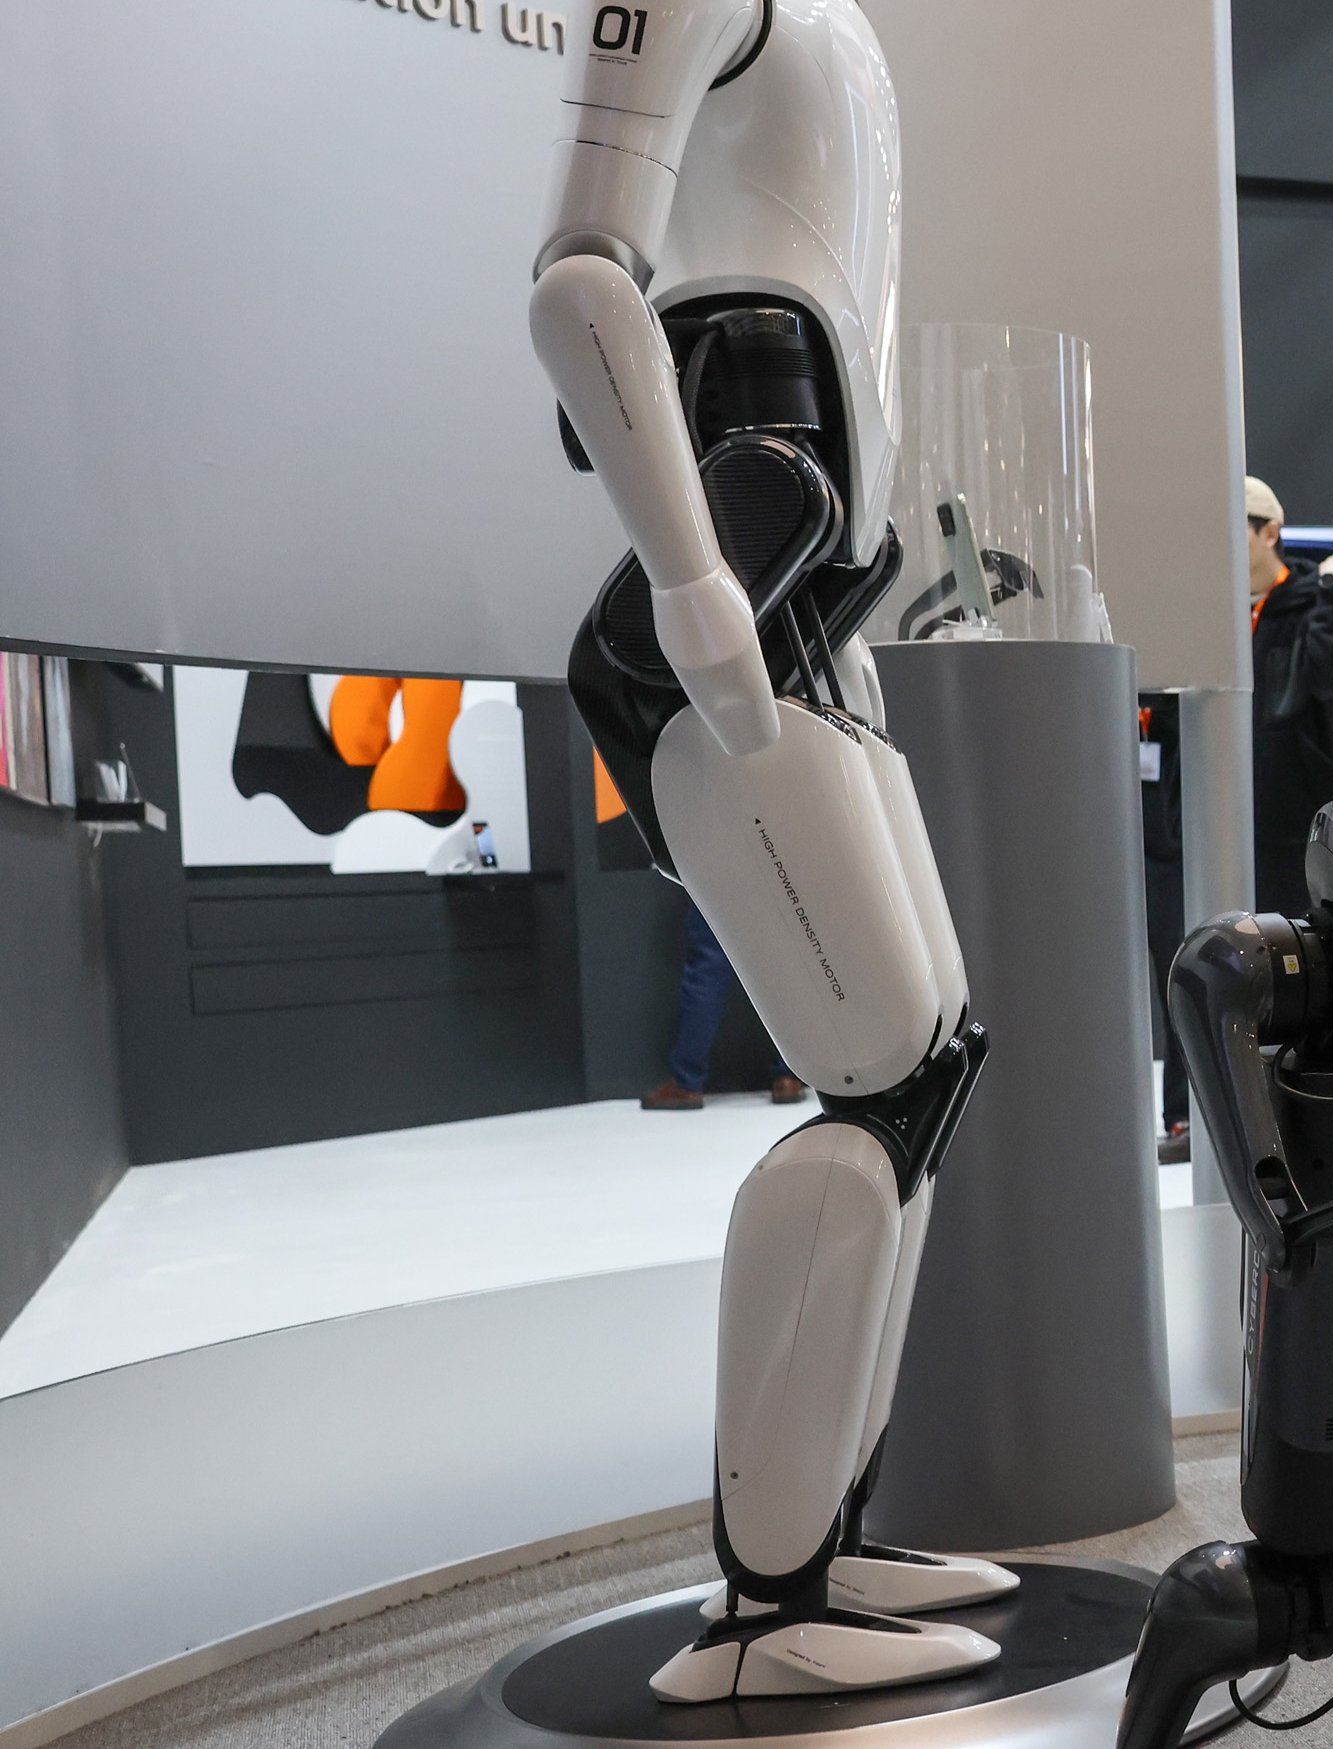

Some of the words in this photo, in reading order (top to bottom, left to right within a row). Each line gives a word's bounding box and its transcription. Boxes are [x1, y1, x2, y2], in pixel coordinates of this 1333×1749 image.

[592, 5, 648, 55] 01
[759, 828, 777, 858] HIGH
[774, 861, 799, 905] POWER
[795, 907, 824, 955] DENSITY
[820, 958, 845, 1001] MOTOR
[1247, 1249, 1261, 1355] CYBERD
